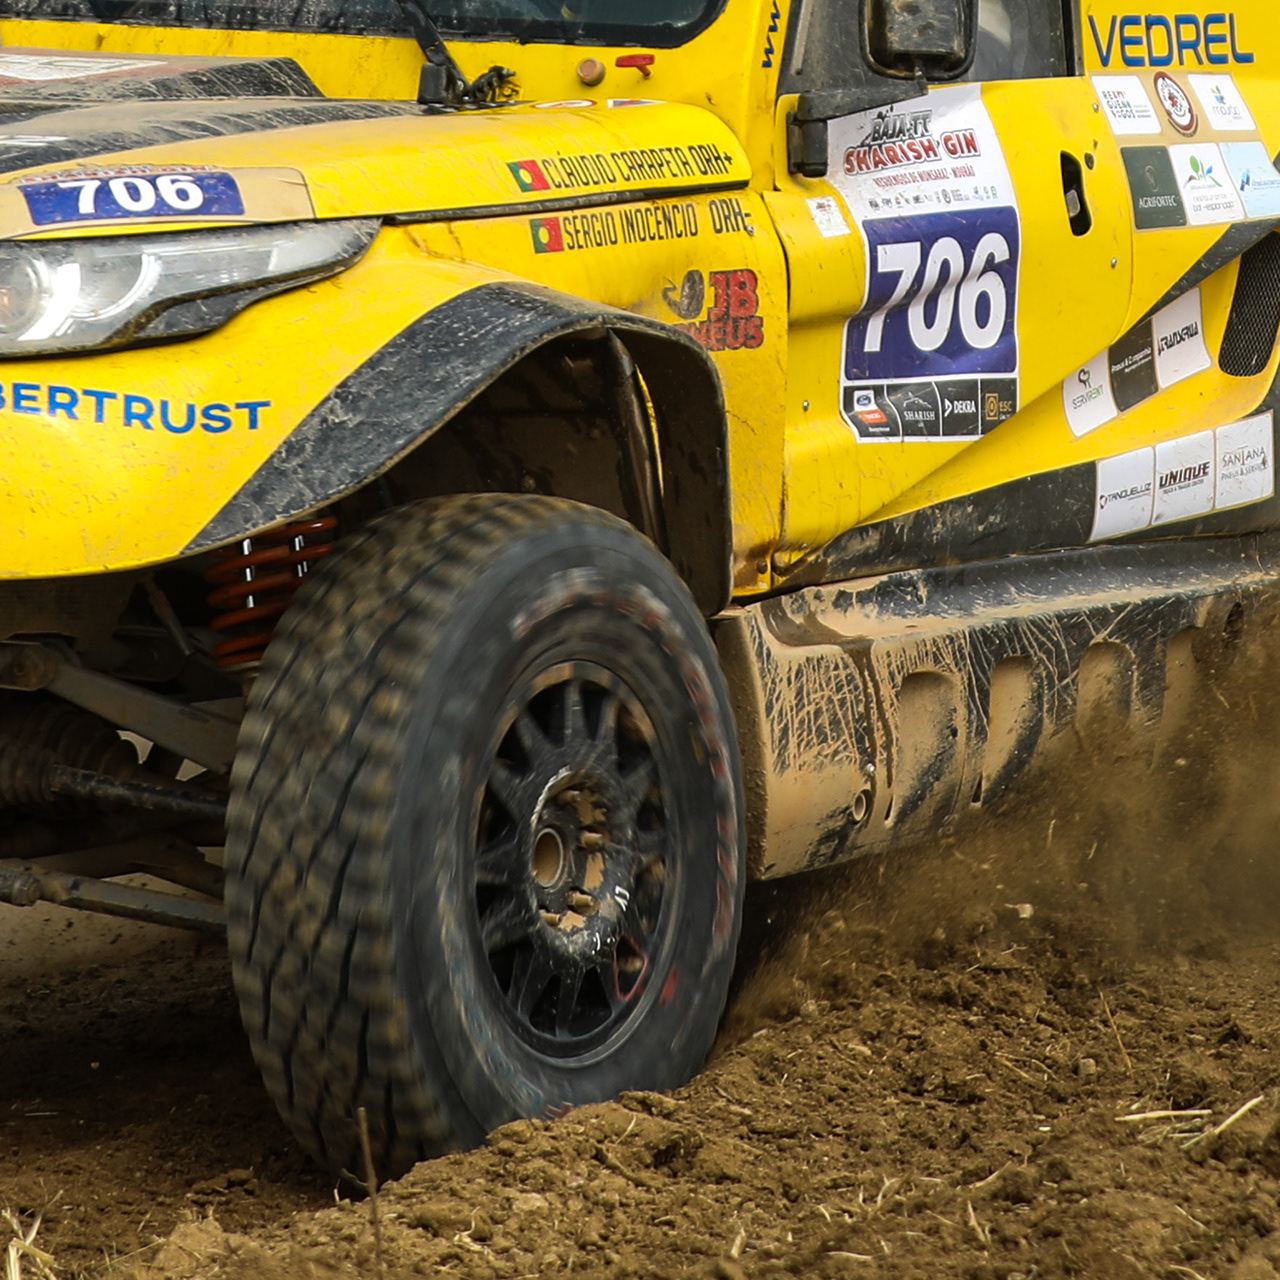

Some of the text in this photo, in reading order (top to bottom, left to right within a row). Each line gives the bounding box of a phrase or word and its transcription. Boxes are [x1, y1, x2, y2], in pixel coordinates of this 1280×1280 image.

[1088, 12, 1254, 67] VEDREL
[610, 146, 692, 182] CARAPETA
[843, 128, 980, 175] SHARISH GIN
[57, 174, 205, 215] 706
[1139, 195, 1178, 209] AGRIFORTEC
[564, 207, 619, 251] SÉRGIO
[707, 269, 758, 322] JB
[862, 232, 1011, 353] 706
[904, 411, 936, 420] SHARISH
[953, 400, 977, 414] DEKRA
[999, 401, 1013, 412] ESC
[1222, 445, 1267, 468] SANTANA
[1158, 461, 1211, 490] UNIQUE
